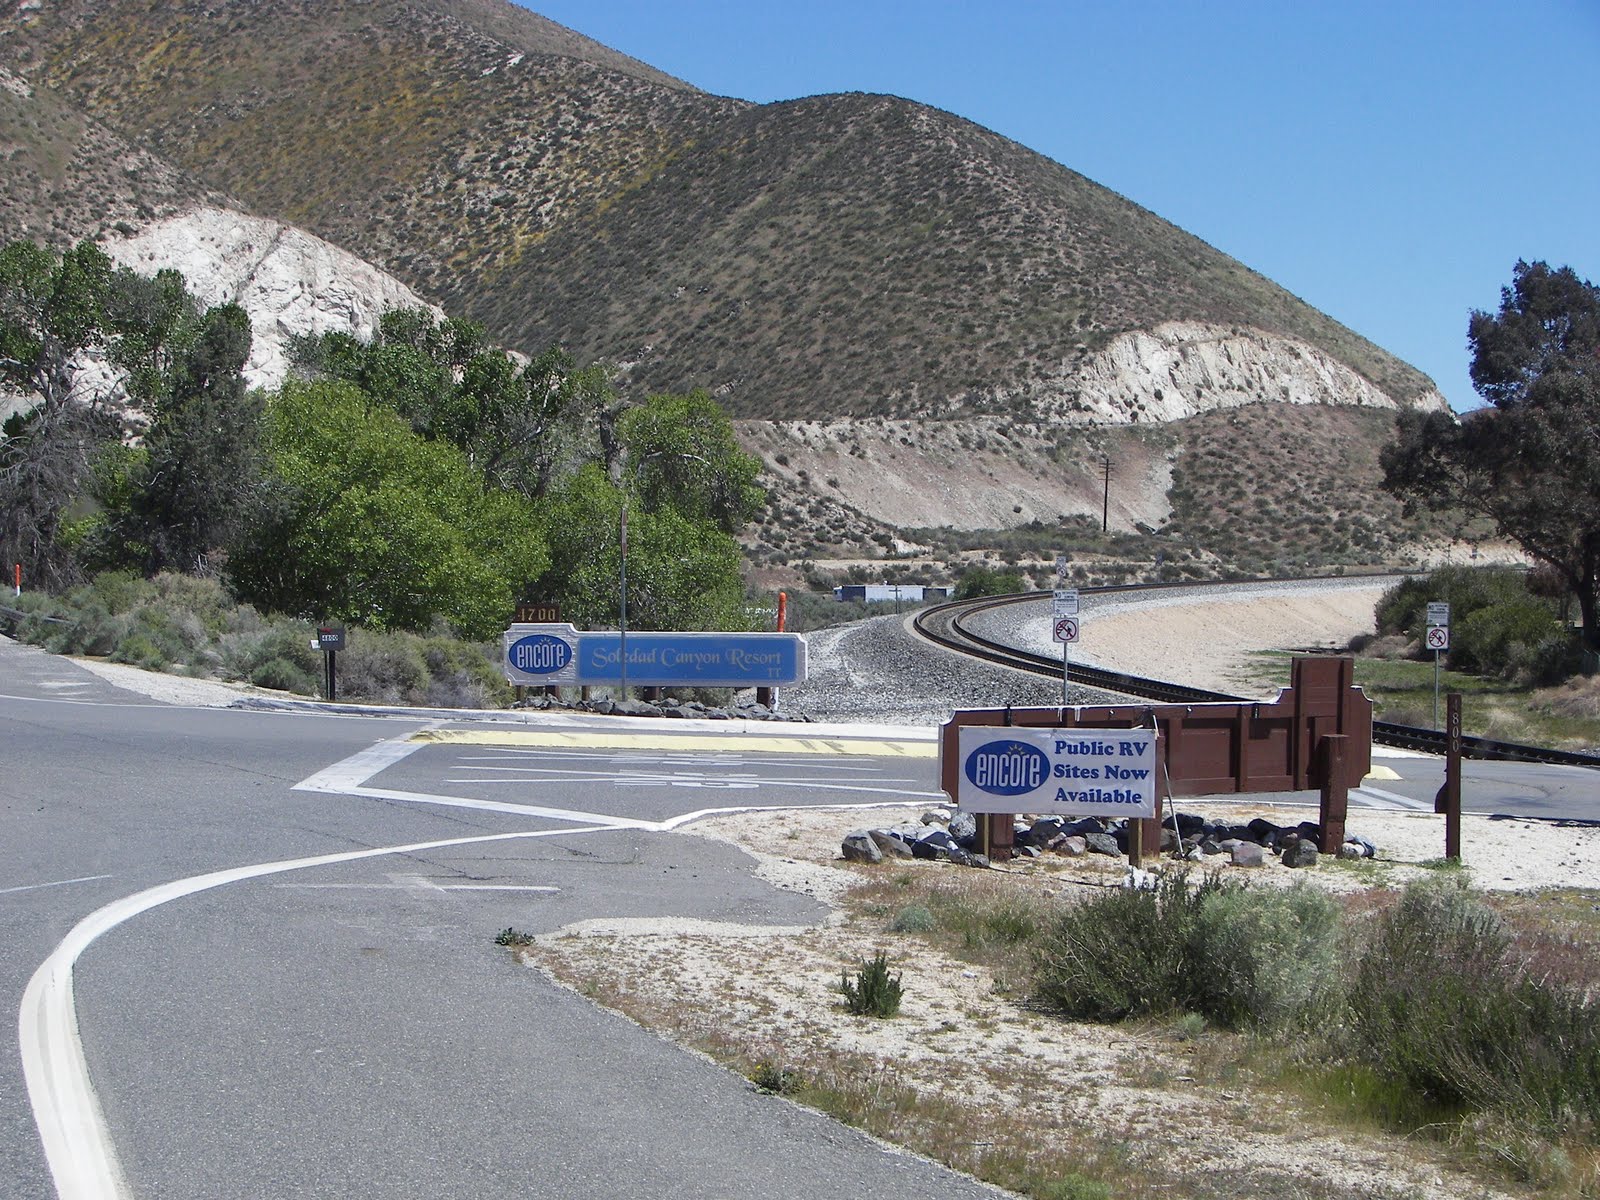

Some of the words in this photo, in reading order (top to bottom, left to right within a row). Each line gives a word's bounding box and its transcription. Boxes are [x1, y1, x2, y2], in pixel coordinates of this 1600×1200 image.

[516, 642, 564, 669] encore
[661, 648, 720, 671] Canyon
[726, 649, 781, 671] Resort
[1054, 740, 1115, 756] Public
[1119, 741, 1149, 757] RV
[976, 753, 1040, 788] encore
[1053, 764, 1099, 779] Sites
[1104, 765, 1149, 780] Now
[1054, 787, 1142, 804] Available
